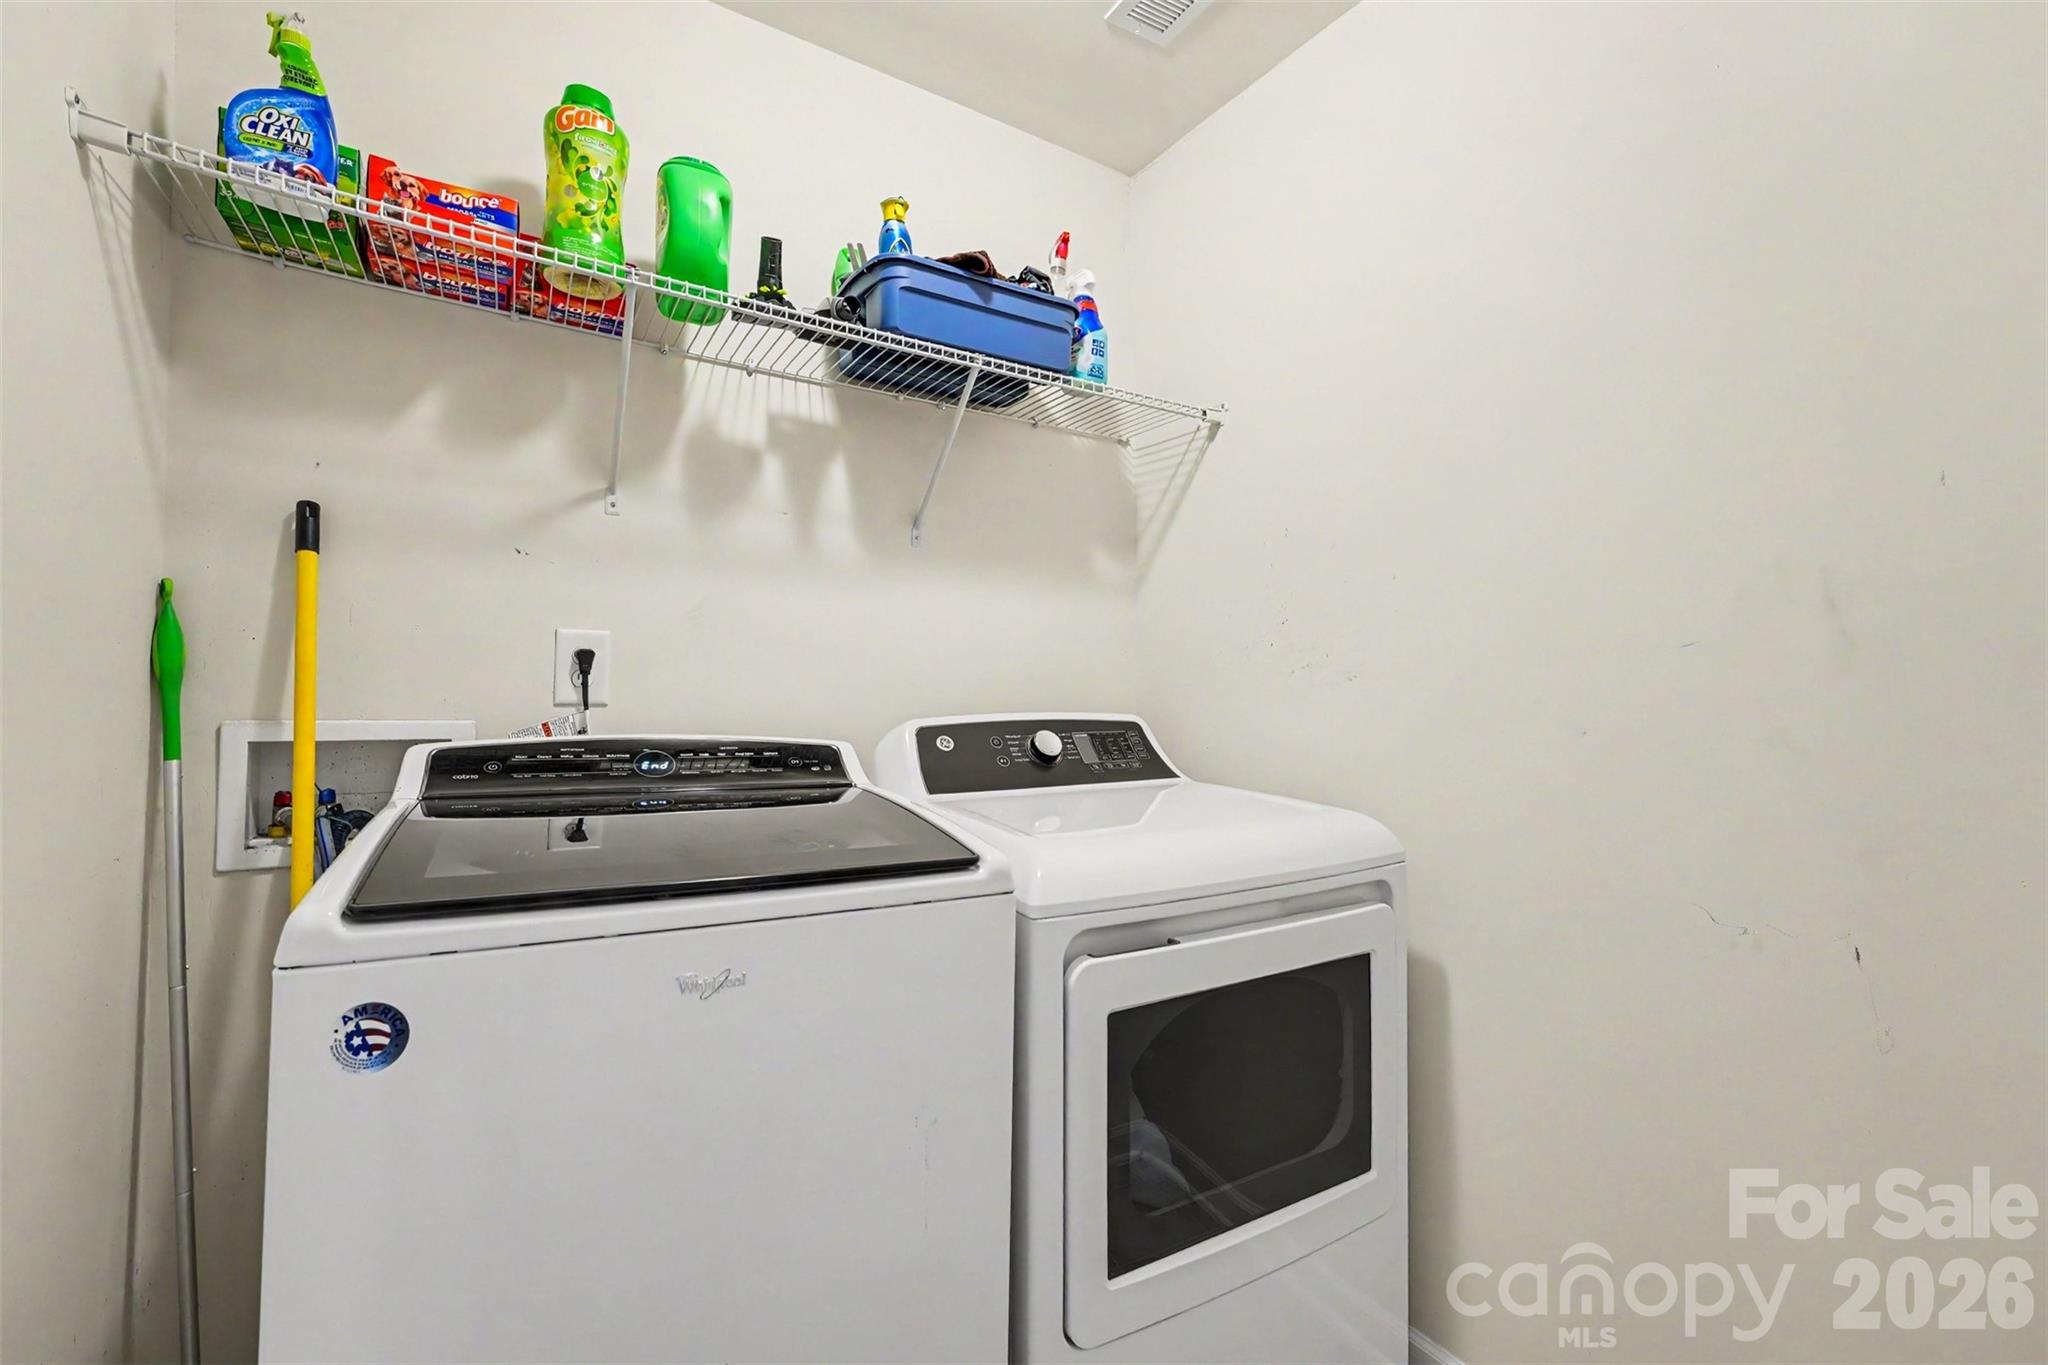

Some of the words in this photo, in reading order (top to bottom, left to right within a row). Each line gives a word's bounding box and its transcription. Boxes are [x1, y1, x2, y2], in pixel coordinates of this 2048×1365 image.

[240, 115, 311, 147] CLEAN
[258, 107, 300, 131] OXI
[556, 105, 616, 135] Gain
[440, 188, 500, 210] bounce
[641, 760, 669, 771] End
